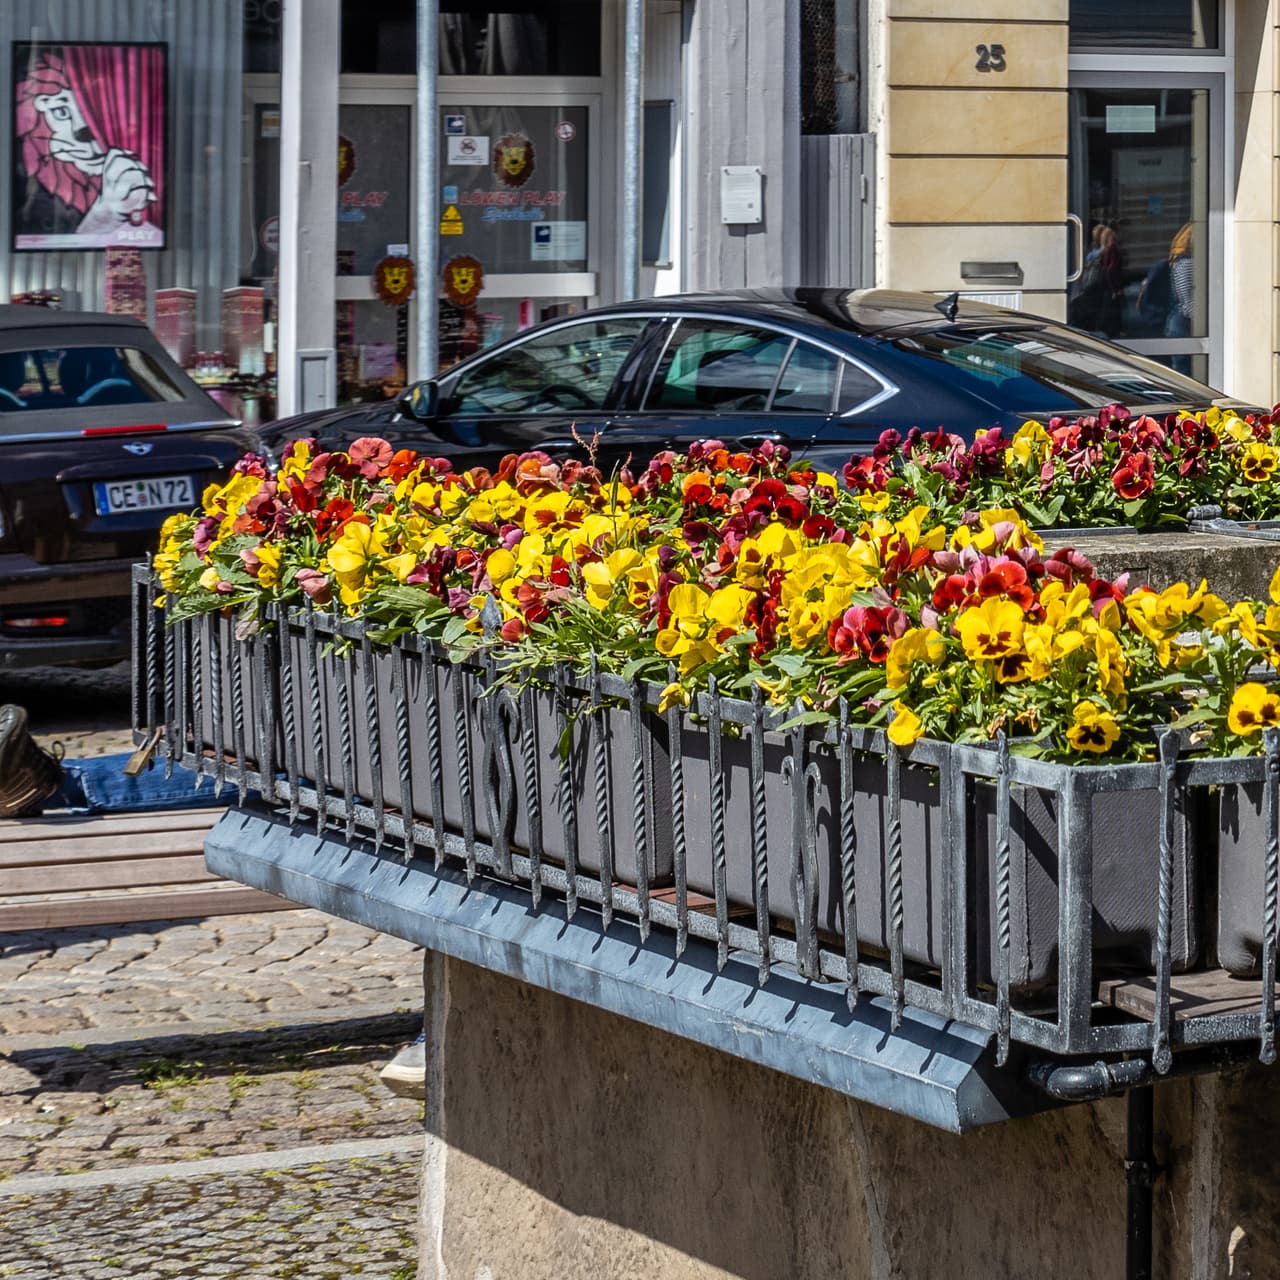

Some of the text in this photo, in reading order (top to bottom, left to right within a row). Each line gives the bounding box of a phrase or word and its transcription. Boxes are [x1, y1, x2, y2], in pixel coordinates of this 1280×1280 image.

[976, 44, 1006, 72] 25
[116, 229, 155, 242] PLAY
[109, 480, 190, 509] CE N 72
